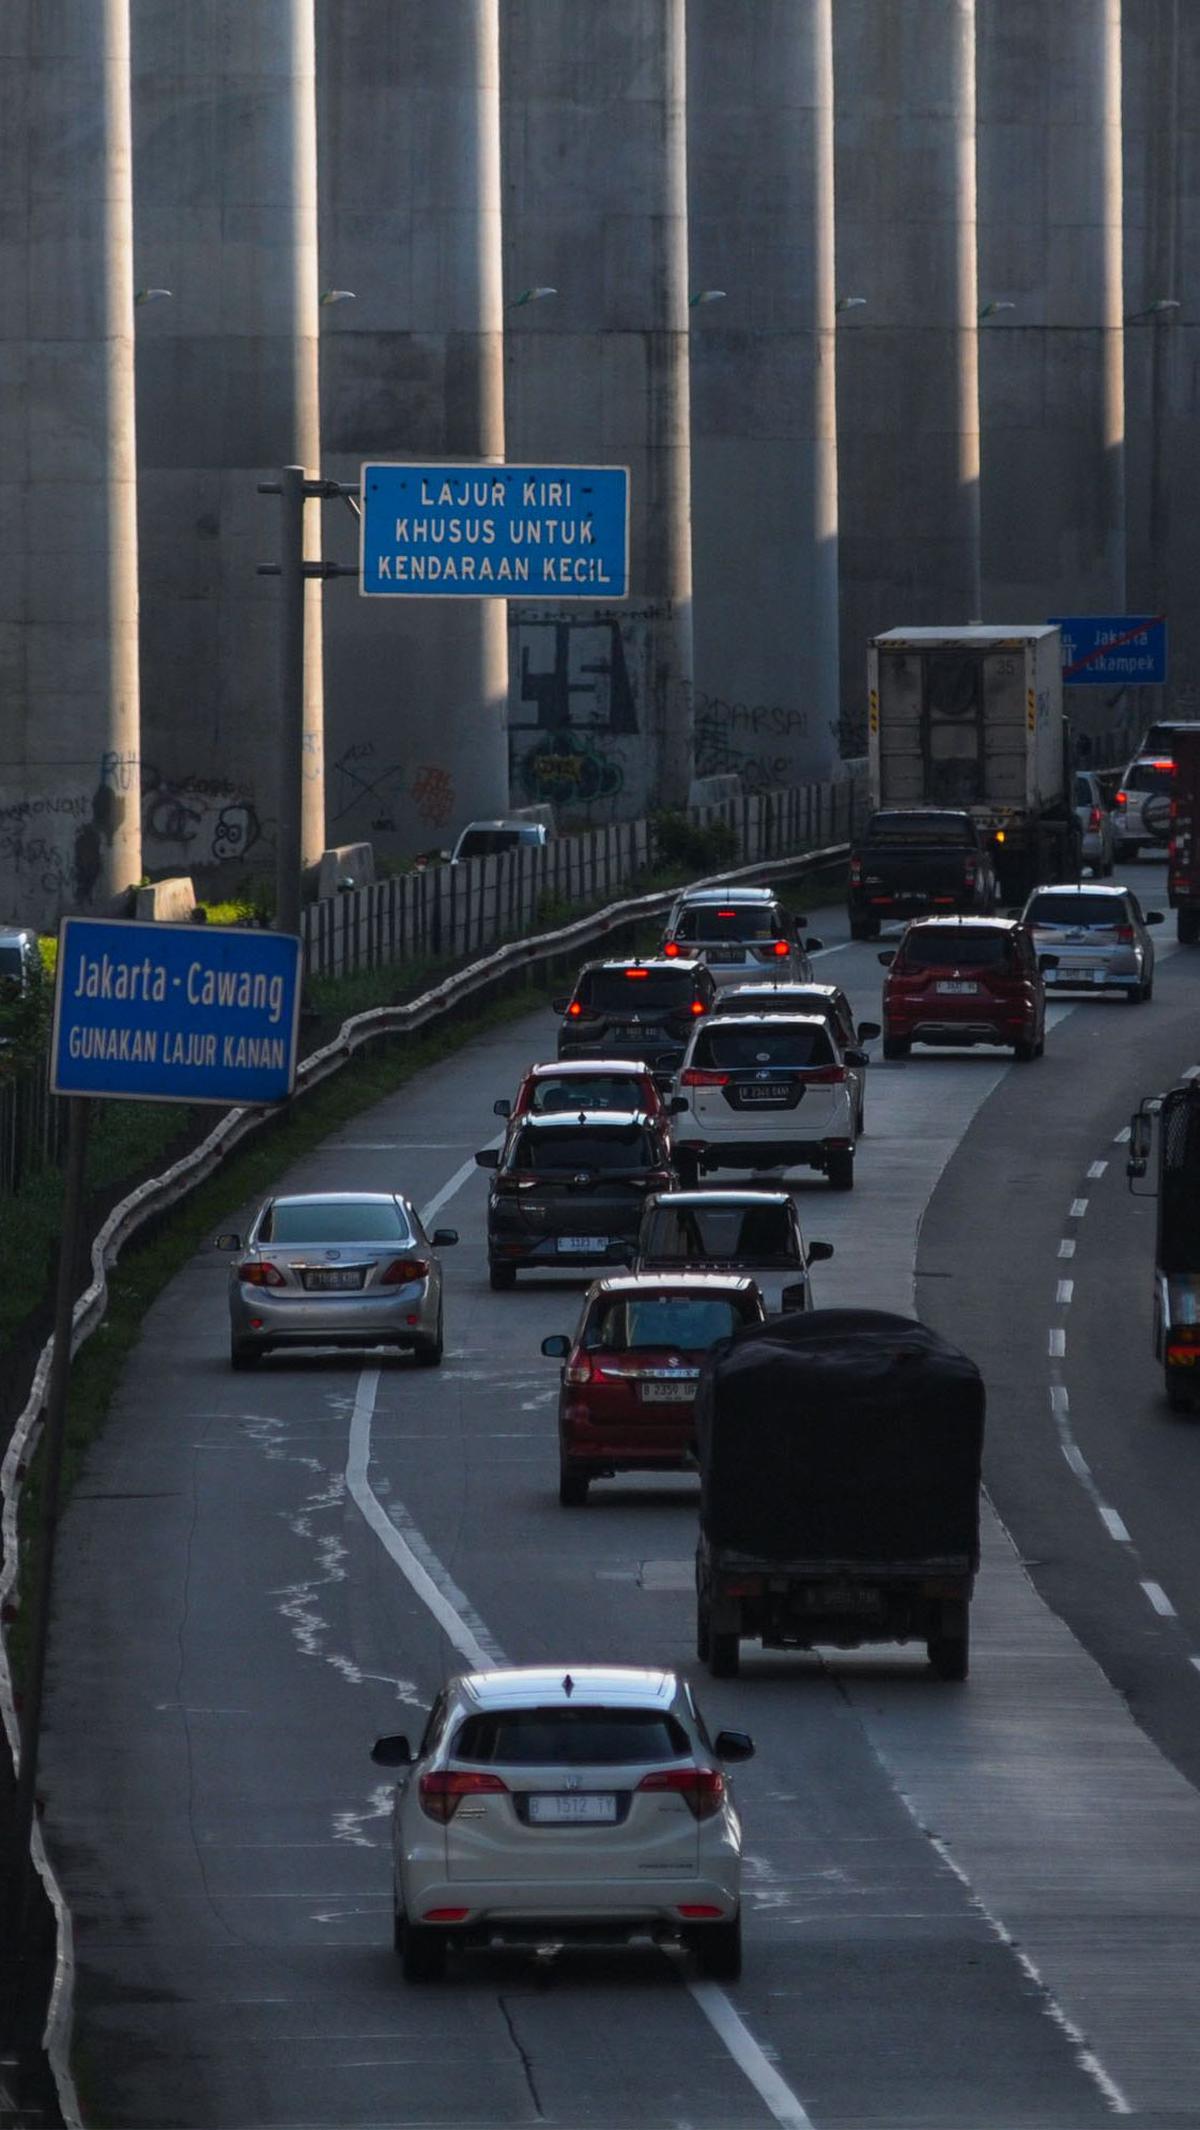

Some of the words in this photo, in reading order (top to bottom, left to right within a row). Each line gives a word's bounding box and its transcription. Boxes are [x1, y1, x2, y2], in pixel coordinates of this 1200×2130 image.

[421, 482, 505, 507] LAJUR
[523, 483, 571, 507] KIRI
[395, 518, 496, 543] KHUSUS
[510, 520, 593, 544] UNTUK
[378, 555, 529, 581] KENDARAAN
[543, 558, 611, 583] KECIL
[74, 953, 167, 1001] Jakarta
[187, 962, 285, 1023] Cawang
[69, 1025, 157, 1063] GUNAKAN
[162, 1031, 217, 1066] LAJUR
[223, 1036, 285, 1069] KANAN
